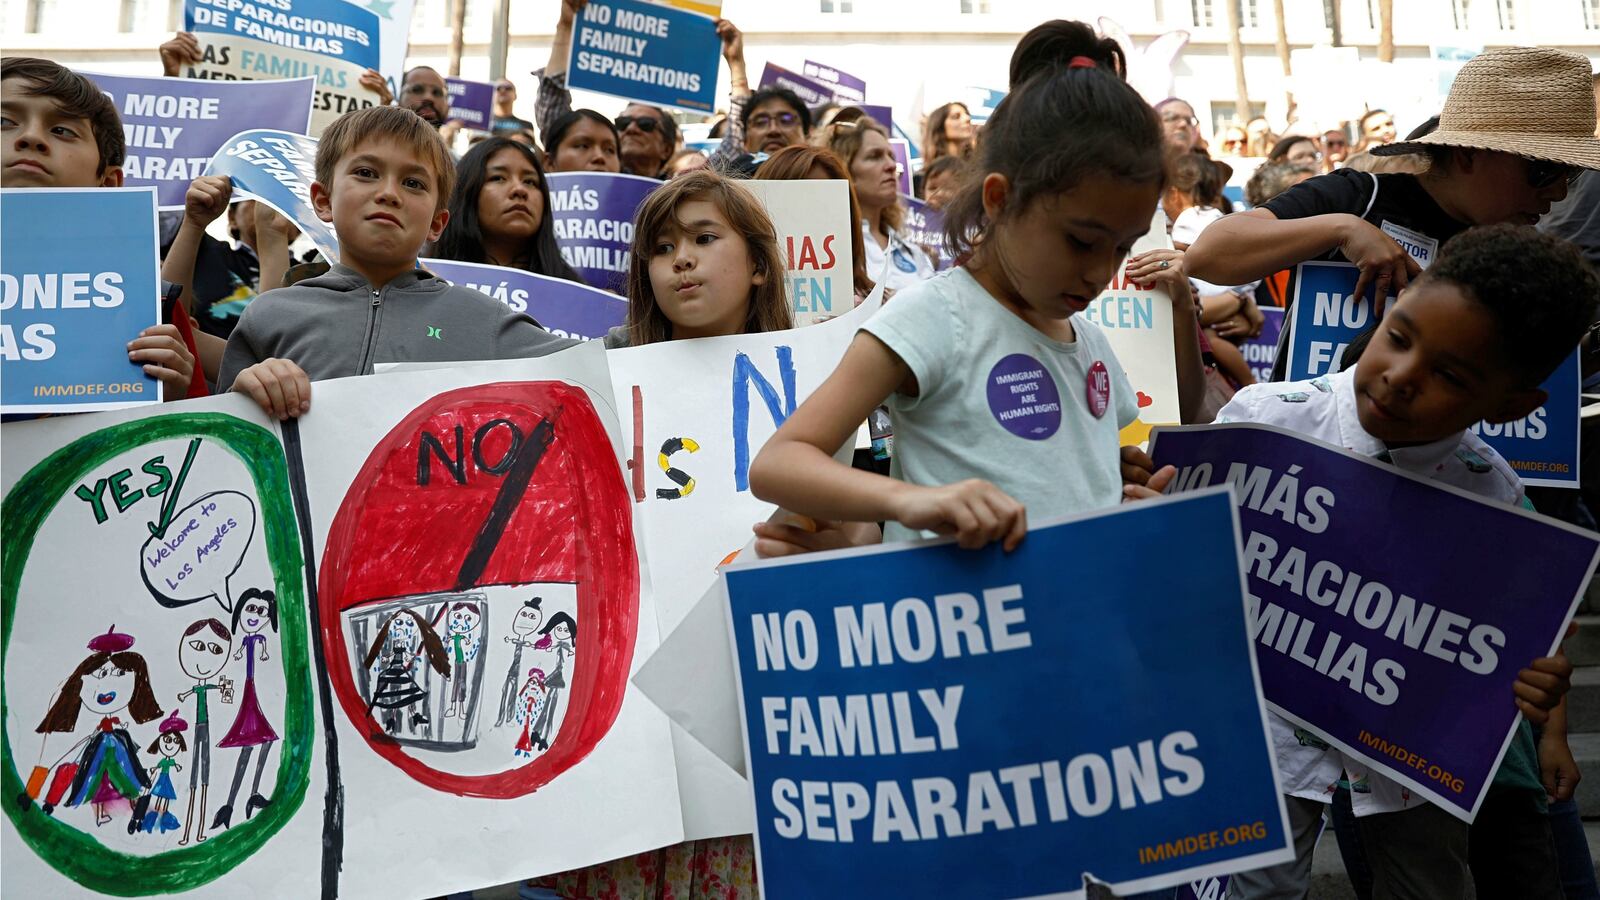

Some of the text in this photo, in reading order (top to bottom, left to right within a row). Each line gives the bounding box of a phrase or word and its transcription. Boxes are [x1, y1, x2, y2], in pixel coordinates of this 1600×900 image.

[194, 6, 344, 54] DE FAMILIAS
[197, 0, 370, 47] EPARACIONES
[583, 3, 670, 38] NO MORE
[202, 44, 231, 66] AS
[580, 27, 648, 58] FAMILY
[577, 51, 701, 93] SEPARATIONS
[124, 94, 219, 119] MORE
[549, 185, 599, 212] MÁS
[554, 218, 637, 244] ARACIO
[787, 235, 836, 270] IAS
[1313, 292, 1369, 329] NO
[34, 383, 144, 397] IMMDEF.ORG
[995, 370, 1043, 385] IMMIGRANT
[1010, 382, 1039, 394] RIGHTS
[999, 403, 1059, 420] HUMAN RIGHTS
[1021, 394, 1037, 404] ARE
[416, 418, 525, 486] NO
[74, 455, 173, 525] YES
[1225, 462, 1336, 534] MÁS
[147, 502, 217, 569] Welcome to
[165, 517, 237, 590] Los Angeles
[1245, 530, 1506, 675] RACIONES
[751, 584, 1032, 672] NO MORE
[761, 685, 964, 757] FAMILY
[1358, 729, 1465, 795] IMMDEF.ORG
[771, 731, 1205, 843] SEPARATIONS
[1138, 821, 1267, 864] IMMDEF.ORG
